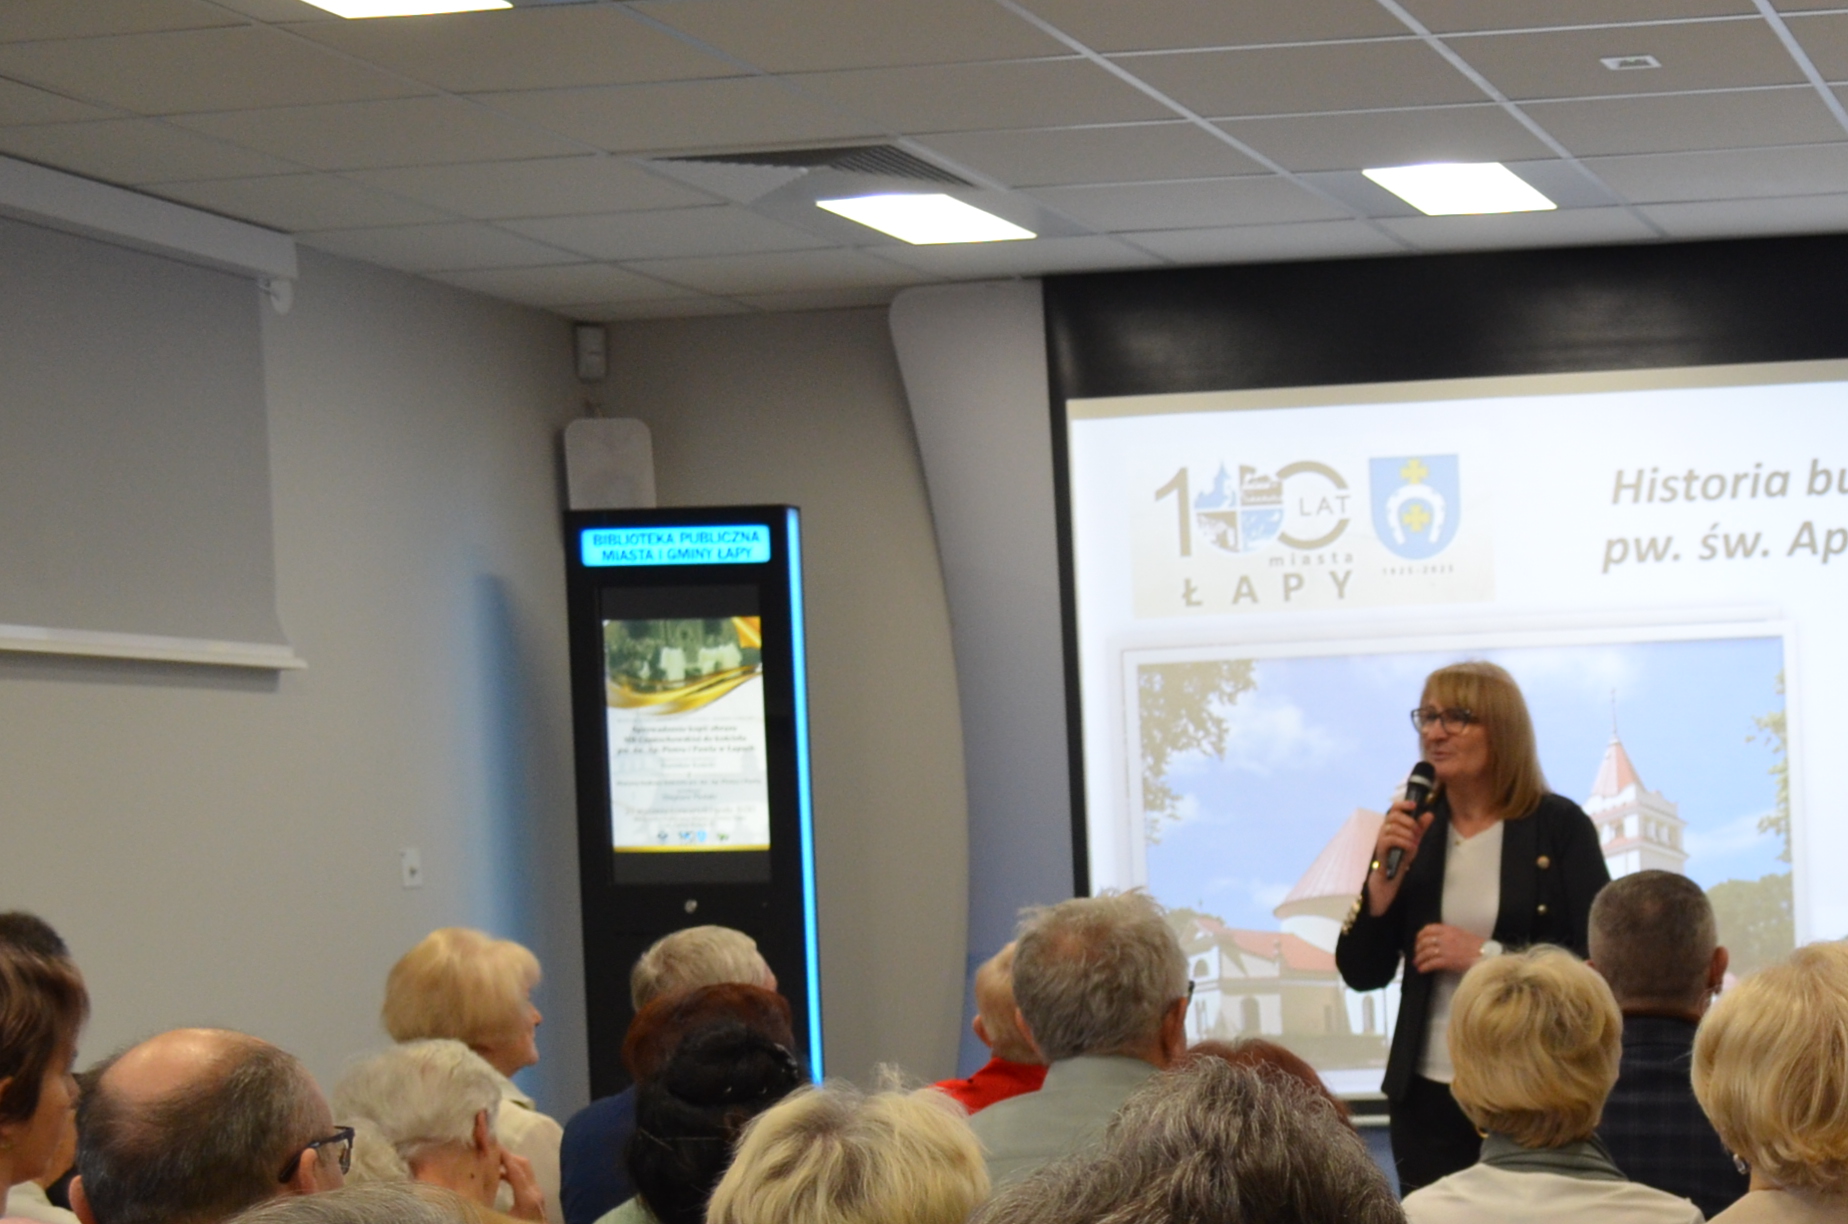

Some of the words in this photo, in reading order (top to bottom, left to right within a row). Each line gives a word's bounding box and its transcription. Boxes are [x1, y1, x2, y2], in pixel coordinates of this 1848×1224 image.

[1612, 462, 1791, 505] Historia
[1299, 495, 1351, 517] LAT
[593, 532, 674, 546] BIBLIOTEKA
[680, 530, 761, 544] PUBLICZNA
[1602, 535, 1681, 575] pw.
[1698, 522, 1770, 562] św.
[602, 549, 654, 561] MIASTA
[667, 547, 713, 560] GMINY
[1268, 552, 1354, 567] miasta
[1181, 569, 1353, 607] ŁAPY
